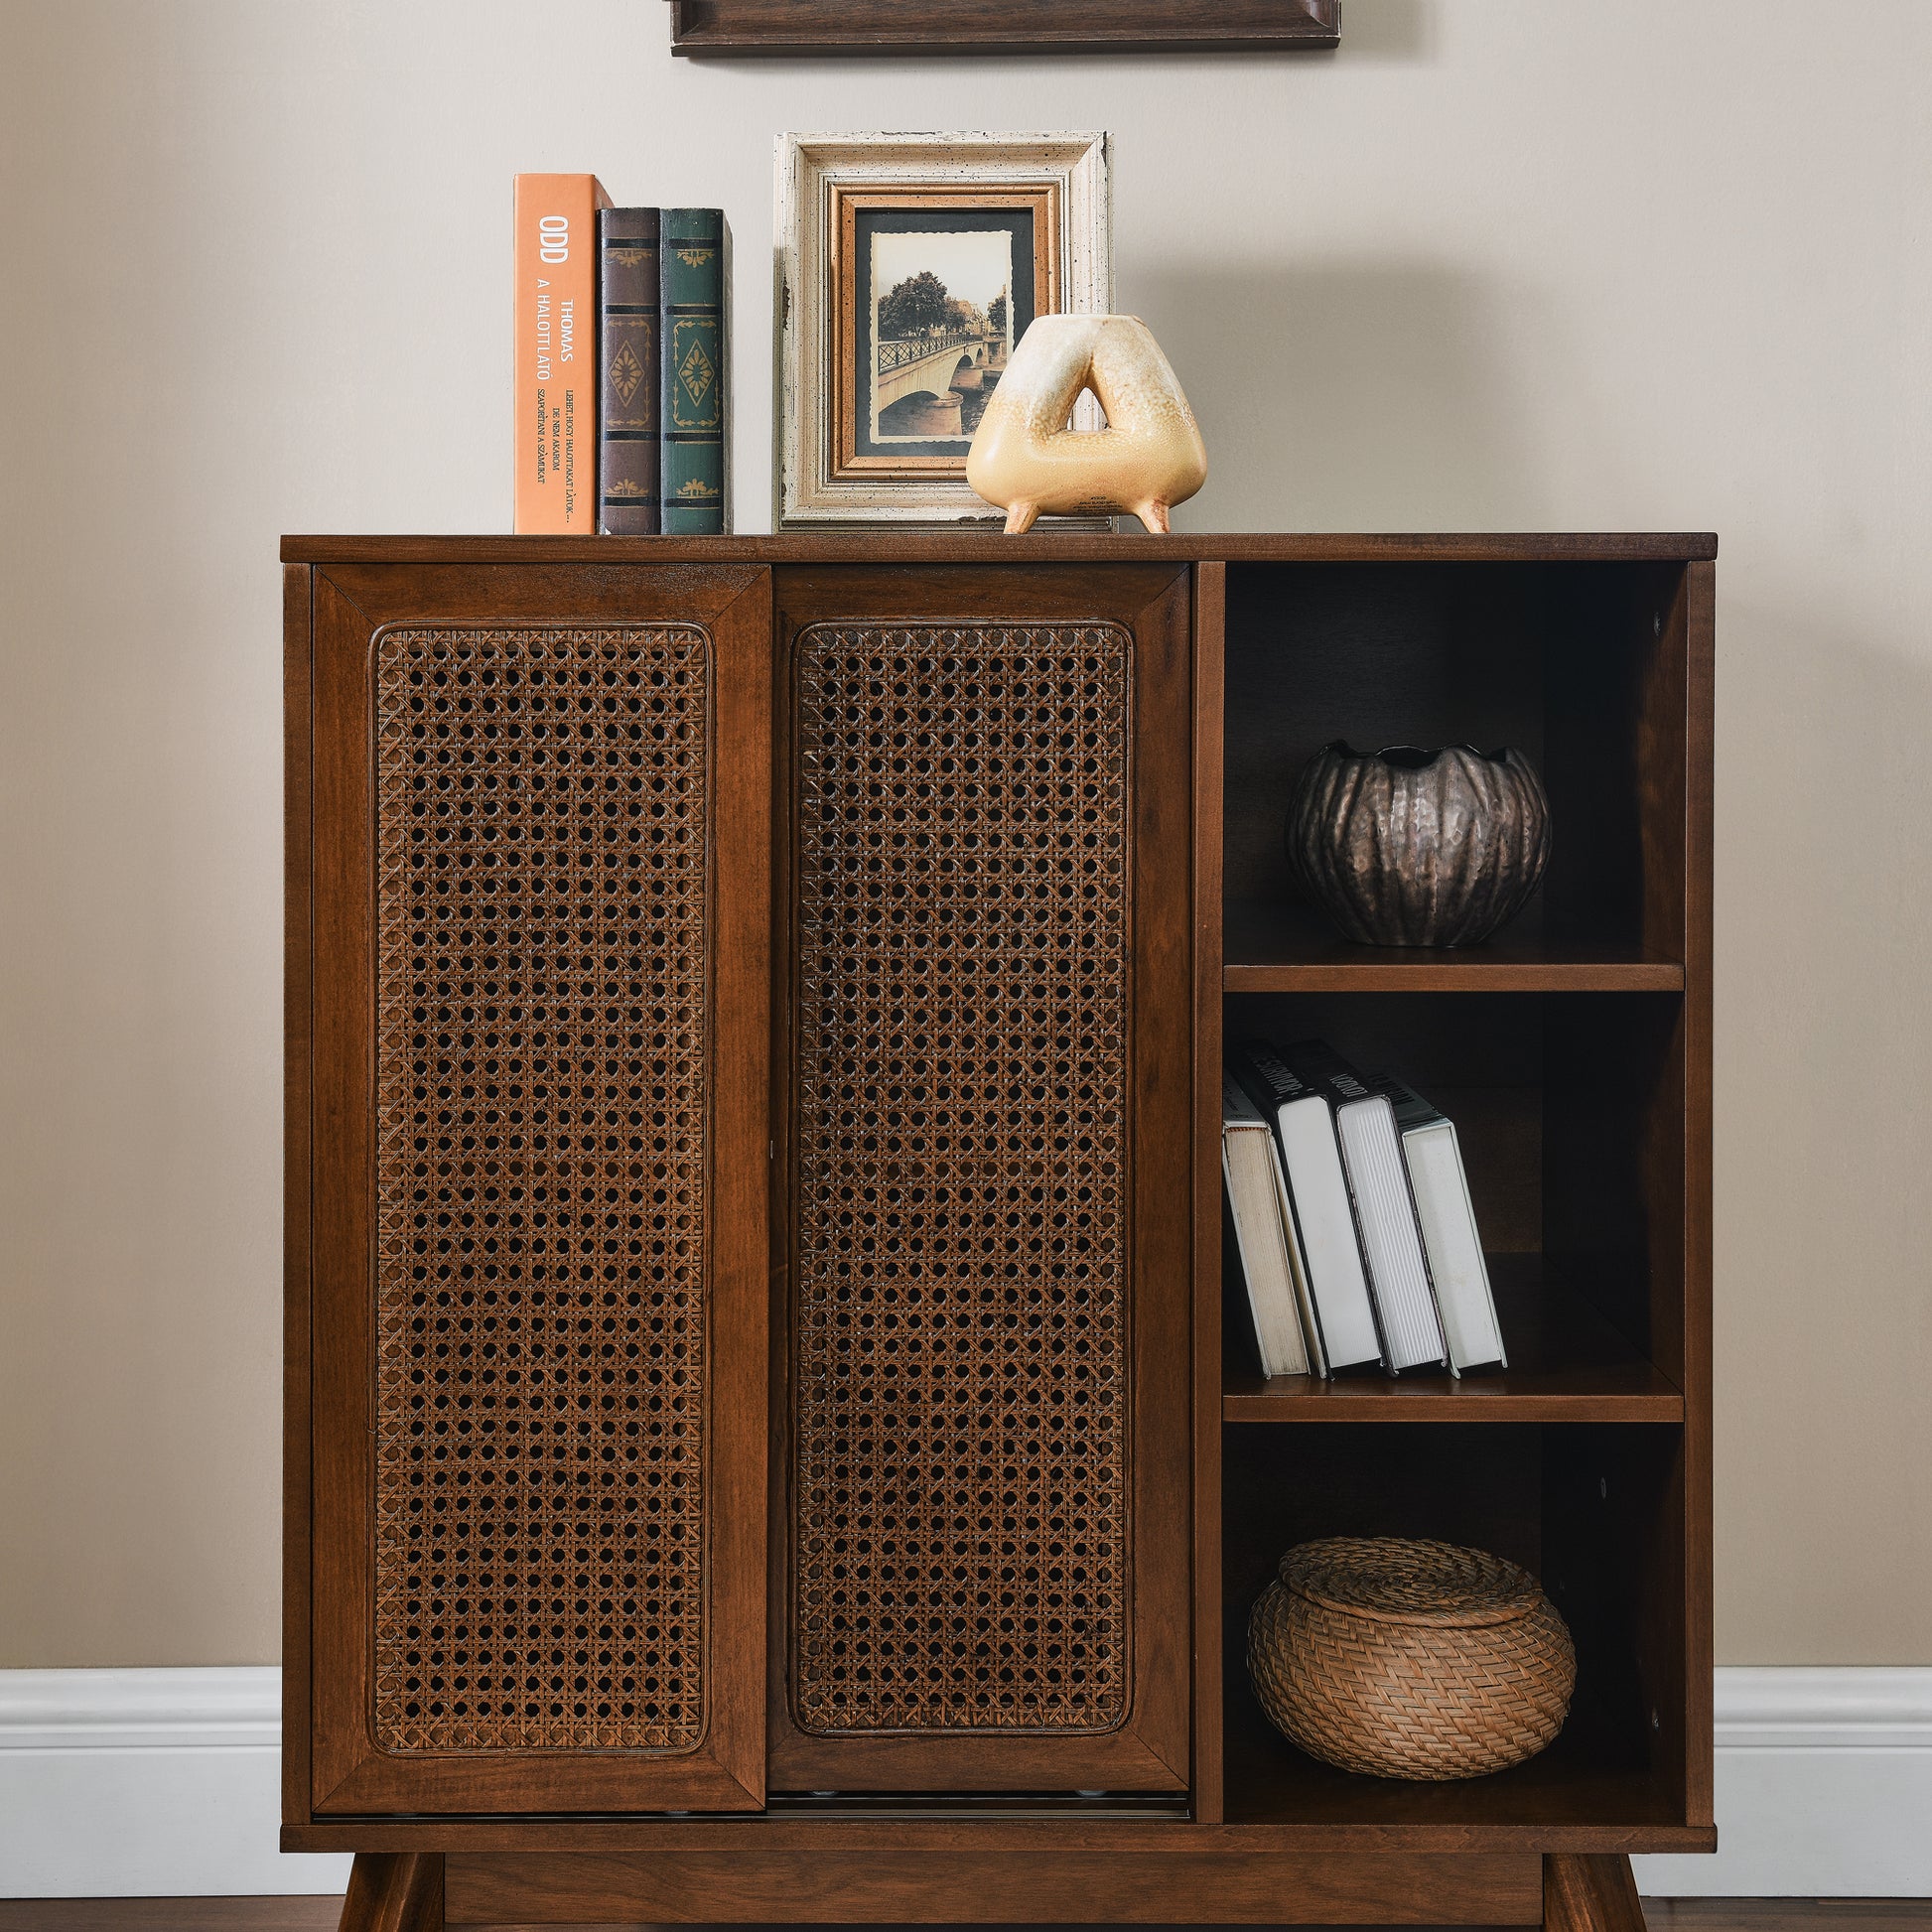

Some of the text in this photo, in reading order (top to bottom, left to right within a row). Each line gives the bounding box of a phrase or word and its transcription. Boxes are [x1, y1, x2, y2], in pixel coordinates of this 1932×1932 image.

[538, 215, 569, 264] ODD
[537, 278, 550, 289] A
[560, 299, 574, 362] THOMAS
[552, 407, 560, 418] DE
[565, 439, 574, 487] HALOTTAKAT
